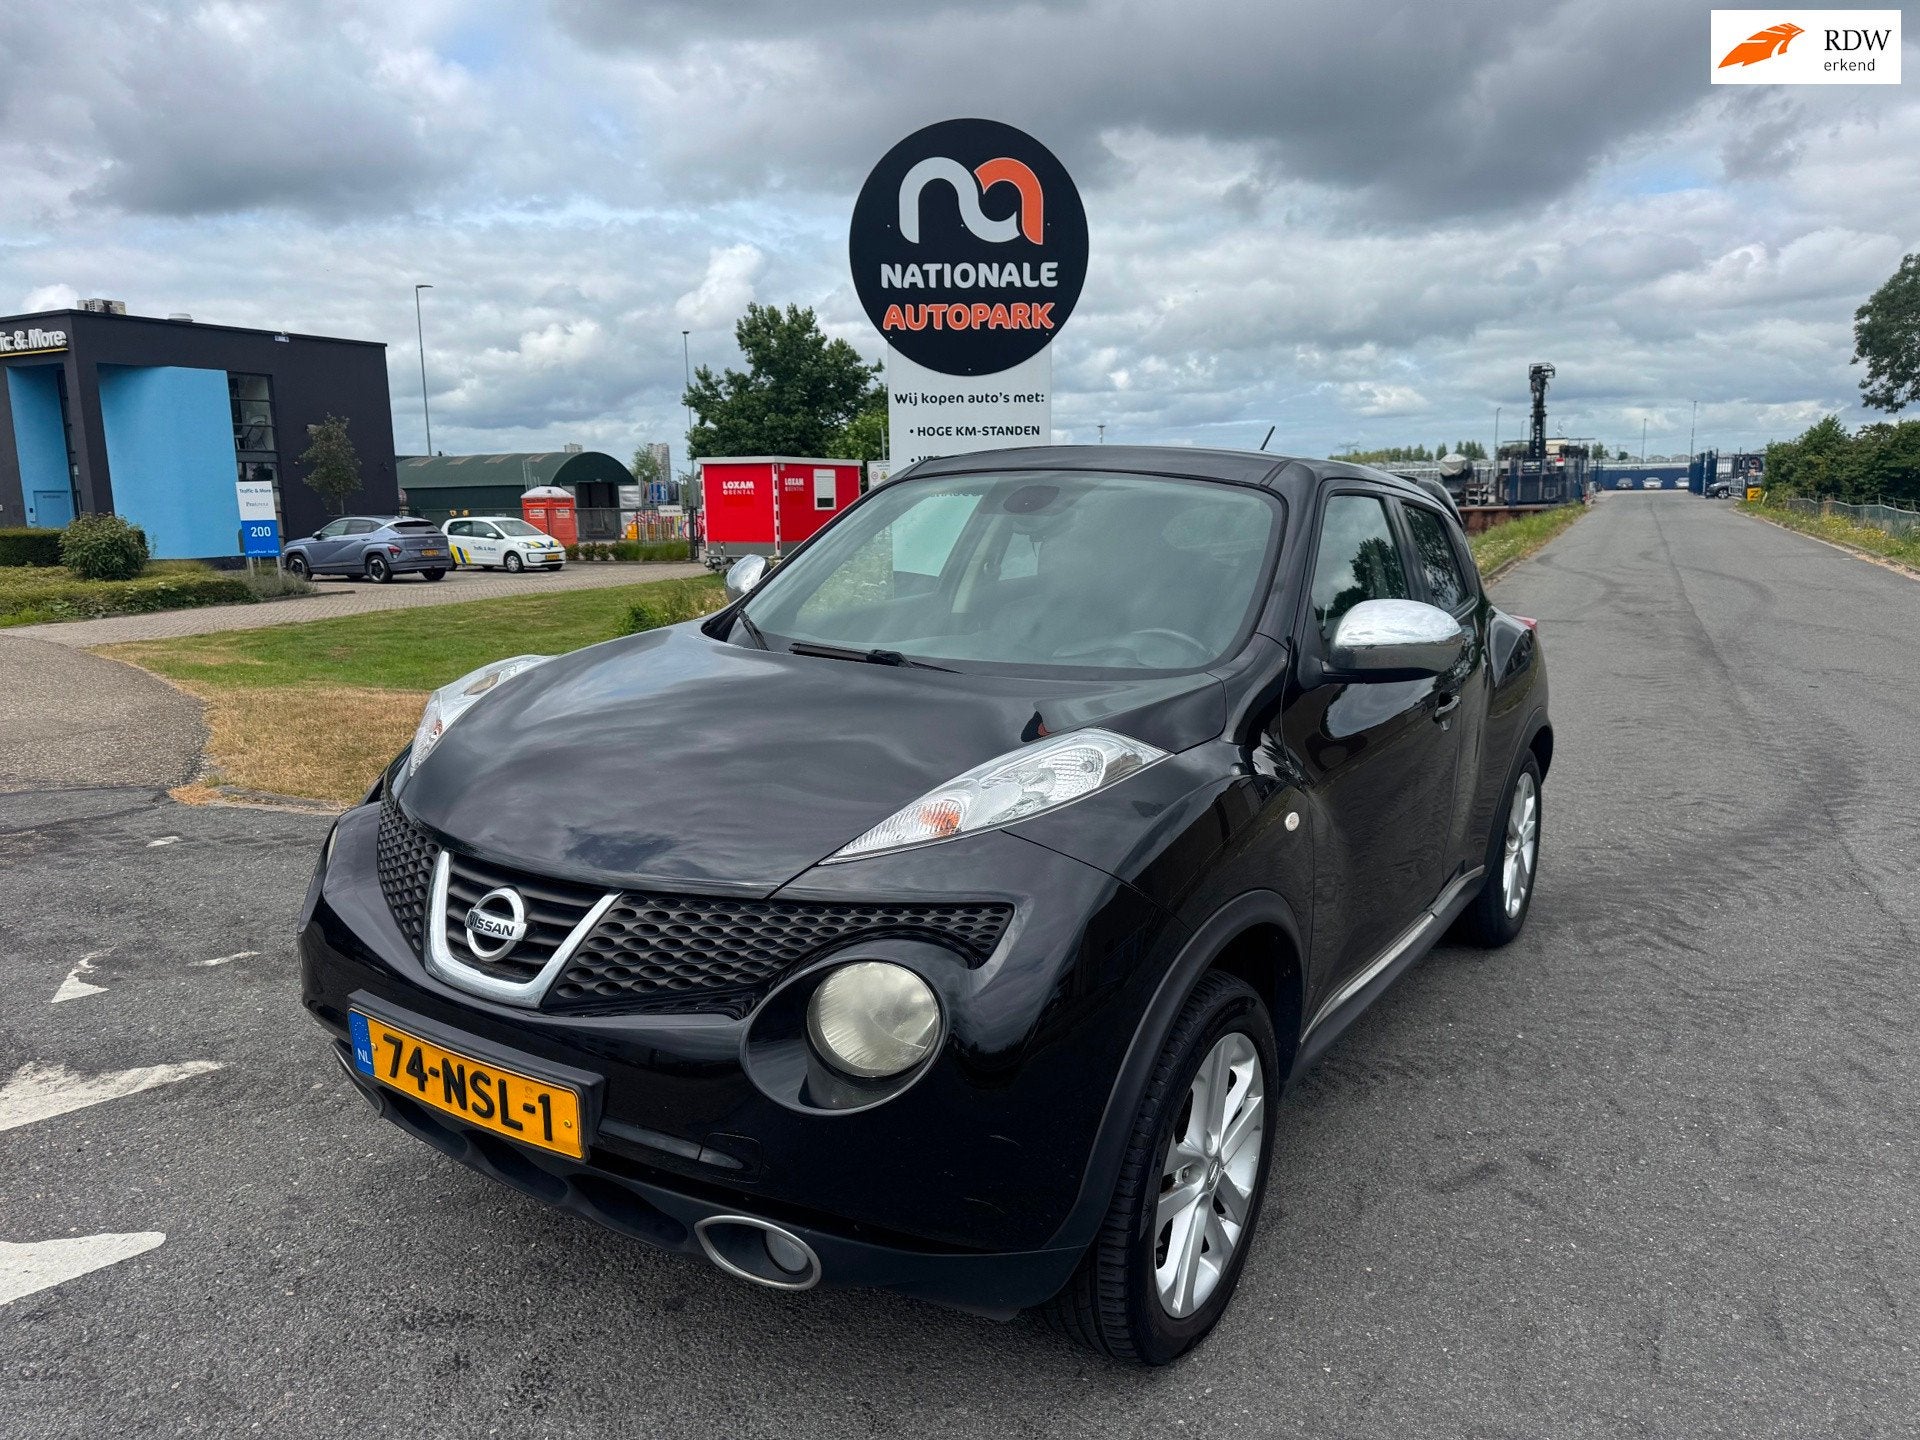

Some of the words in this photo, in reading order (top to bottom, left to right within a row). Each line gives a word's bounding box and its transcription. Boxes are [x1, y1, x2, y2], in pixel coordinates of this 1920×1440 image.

[881, 262, 1059, 289] NATIONALE
[883, 302, 1055, 331] AUTOPARK
[14, 330, 29, 350] &
[28, 328, 67, 349] More
[894, 392, 918, 407] Wij
[921, 392, 965, 406] kopen
[968, 392, 1010, 403] auto's
[1013, 392, 1045, 403] met:
[917, 426, 952, 436] HOGE
[956, 425, 1041, 436] KM-STANDEN
[722, 481, 755, 489] LOXAM
[784, 477, 805, 486] LOXAM
[250, 526, 271, 537] 200
[468, 914, 515, 937] NISSAN
[357, 1047, 371, 1065] NL
[383, 1032, 554, 1142] 74-NSL-1
